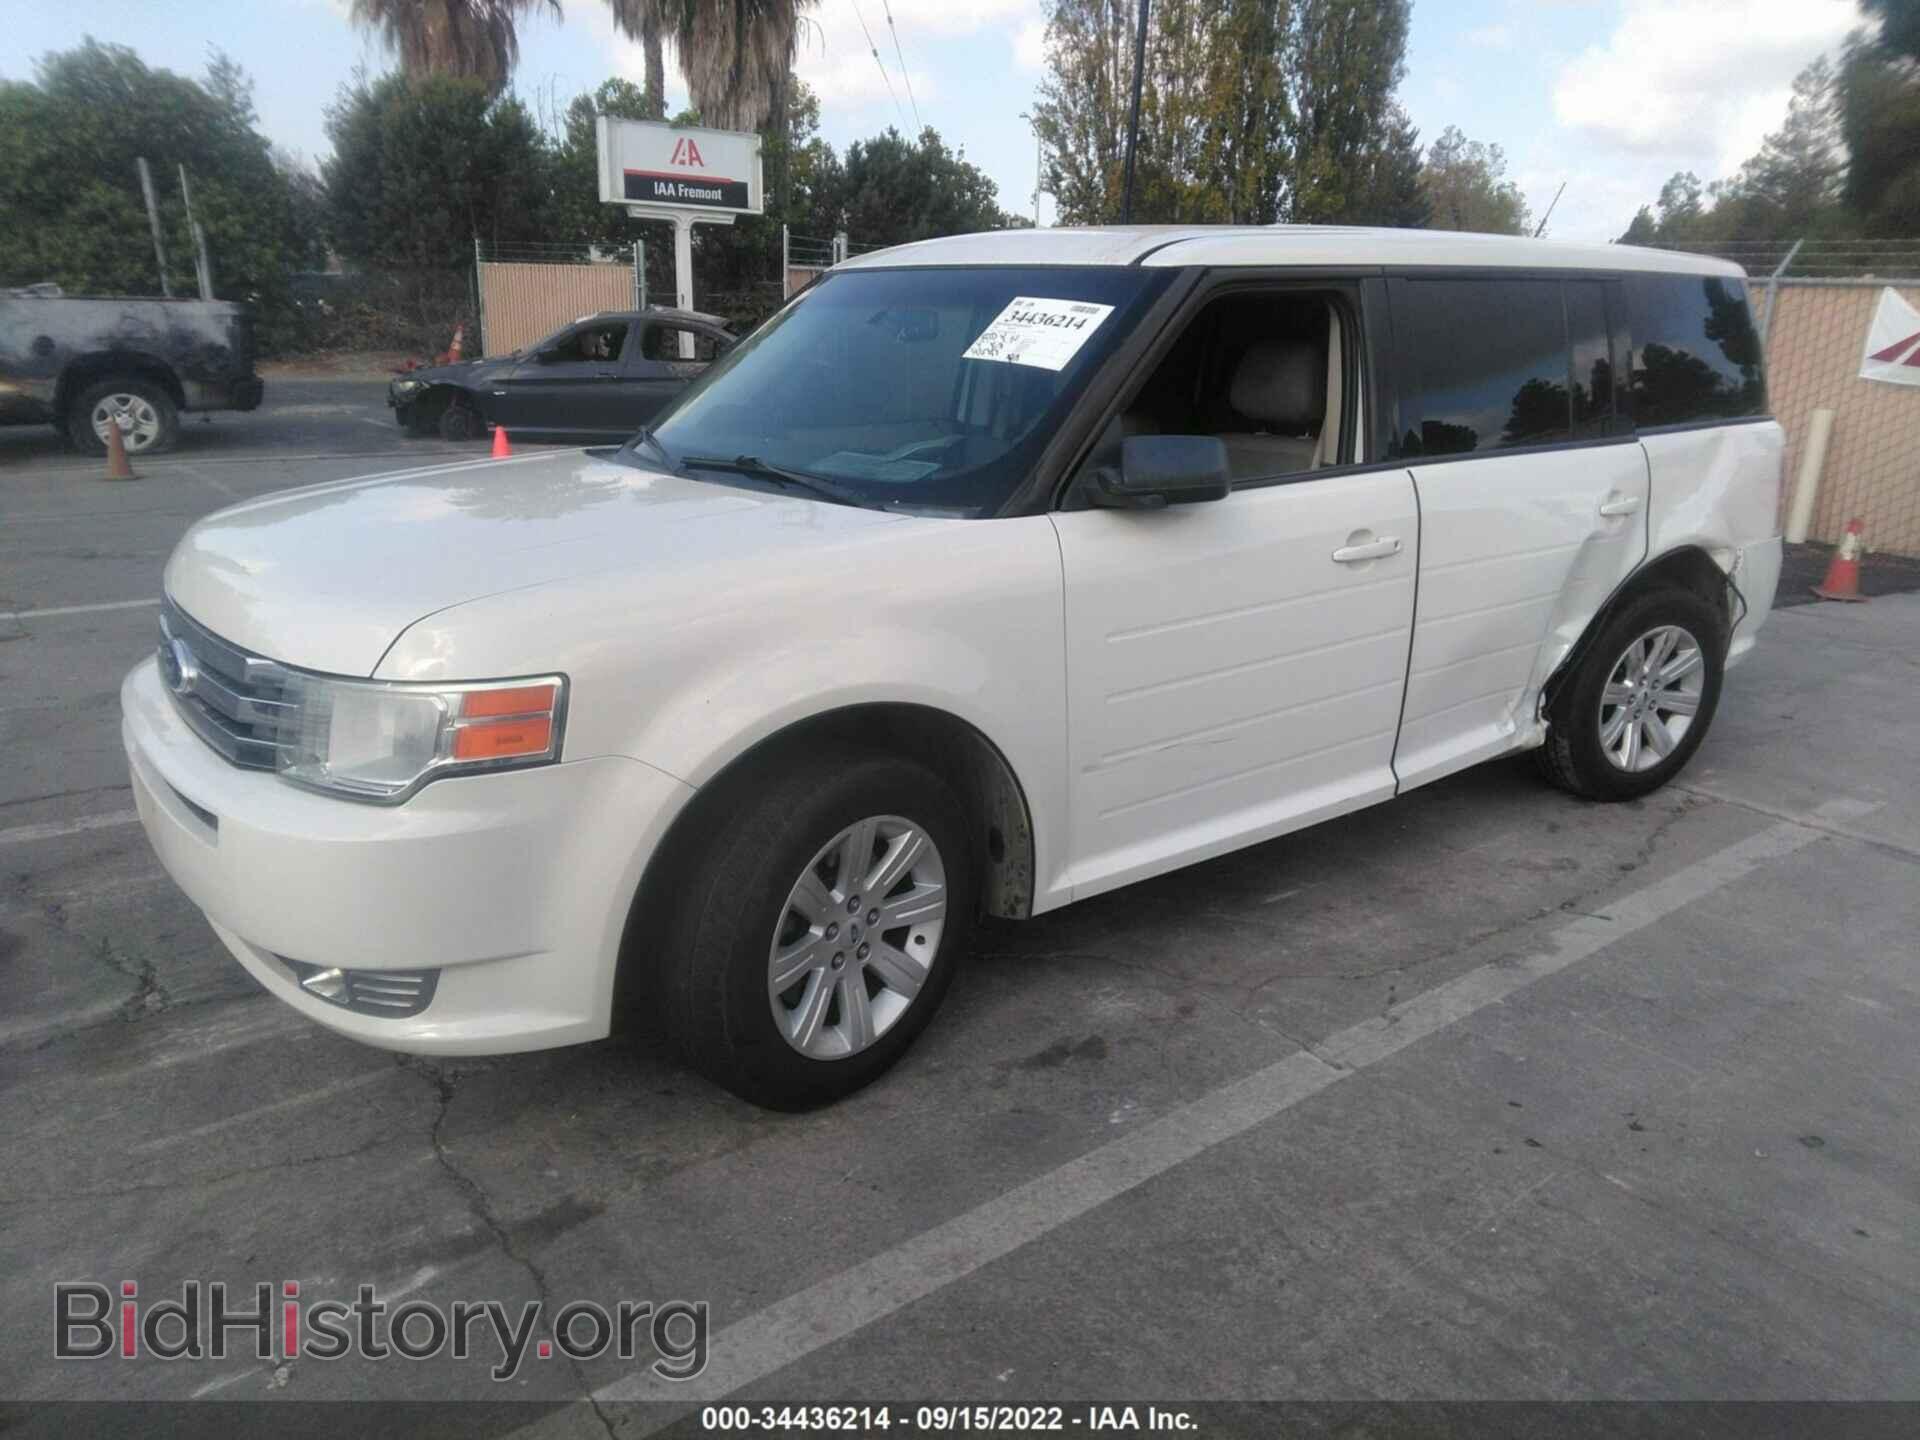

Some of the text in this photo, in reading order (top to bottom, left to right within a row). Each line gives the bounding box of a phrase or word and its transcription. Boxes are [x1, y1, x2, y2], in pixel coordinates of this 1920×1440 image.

[654, 181, 722, 201] IAA Fremont
[1005, 310, 1088, 330] 34436214
